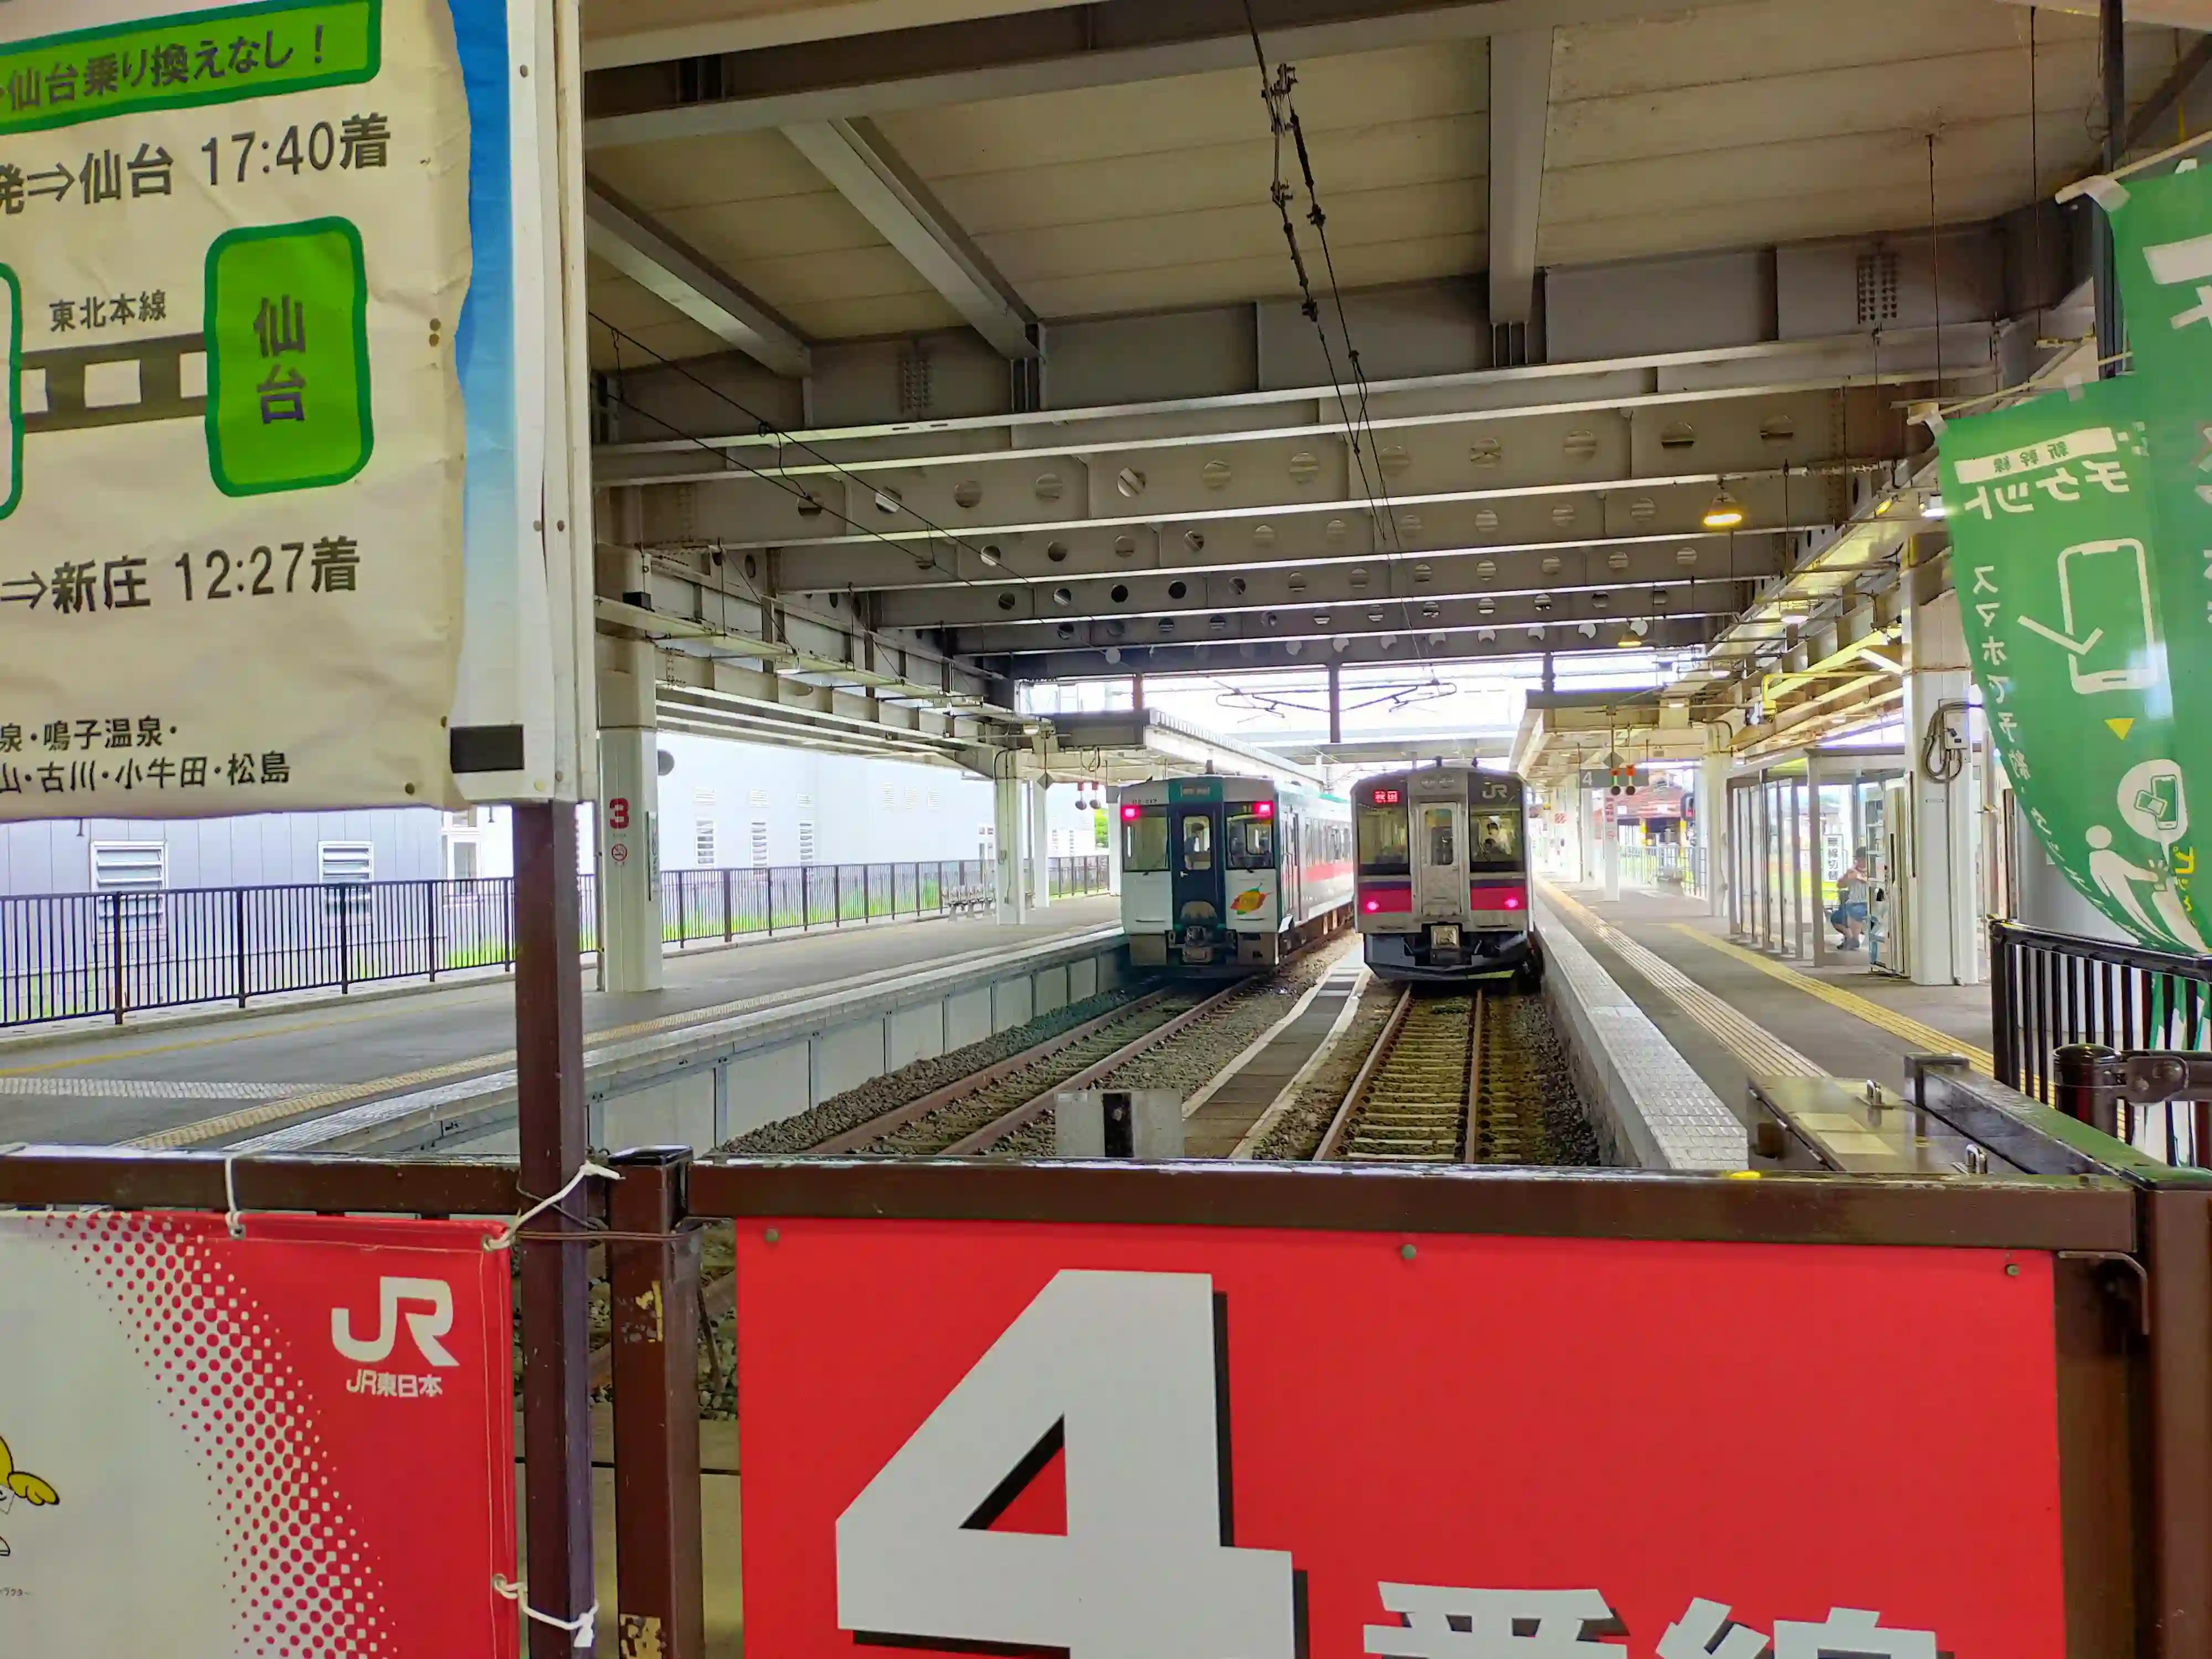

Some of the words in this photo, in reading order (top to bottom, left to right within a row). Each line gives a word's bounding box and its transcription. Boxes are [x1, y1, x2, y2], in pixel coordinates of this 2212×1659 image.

[201, 113, 392, 186] 17:40着
[50, 289, 167, 332] 東北本線
[253, 295, 306, 424] 仙台
[175, 536, 361, 601] 12:27着
[1482, 784, 1507, 799] JR
[1583, 771, 1592, 786] 4
[609, 797, 629, 829] 3
[332, 1276, 460, 1367] JR
[346, 1369, 444, 1398] JR東日本
